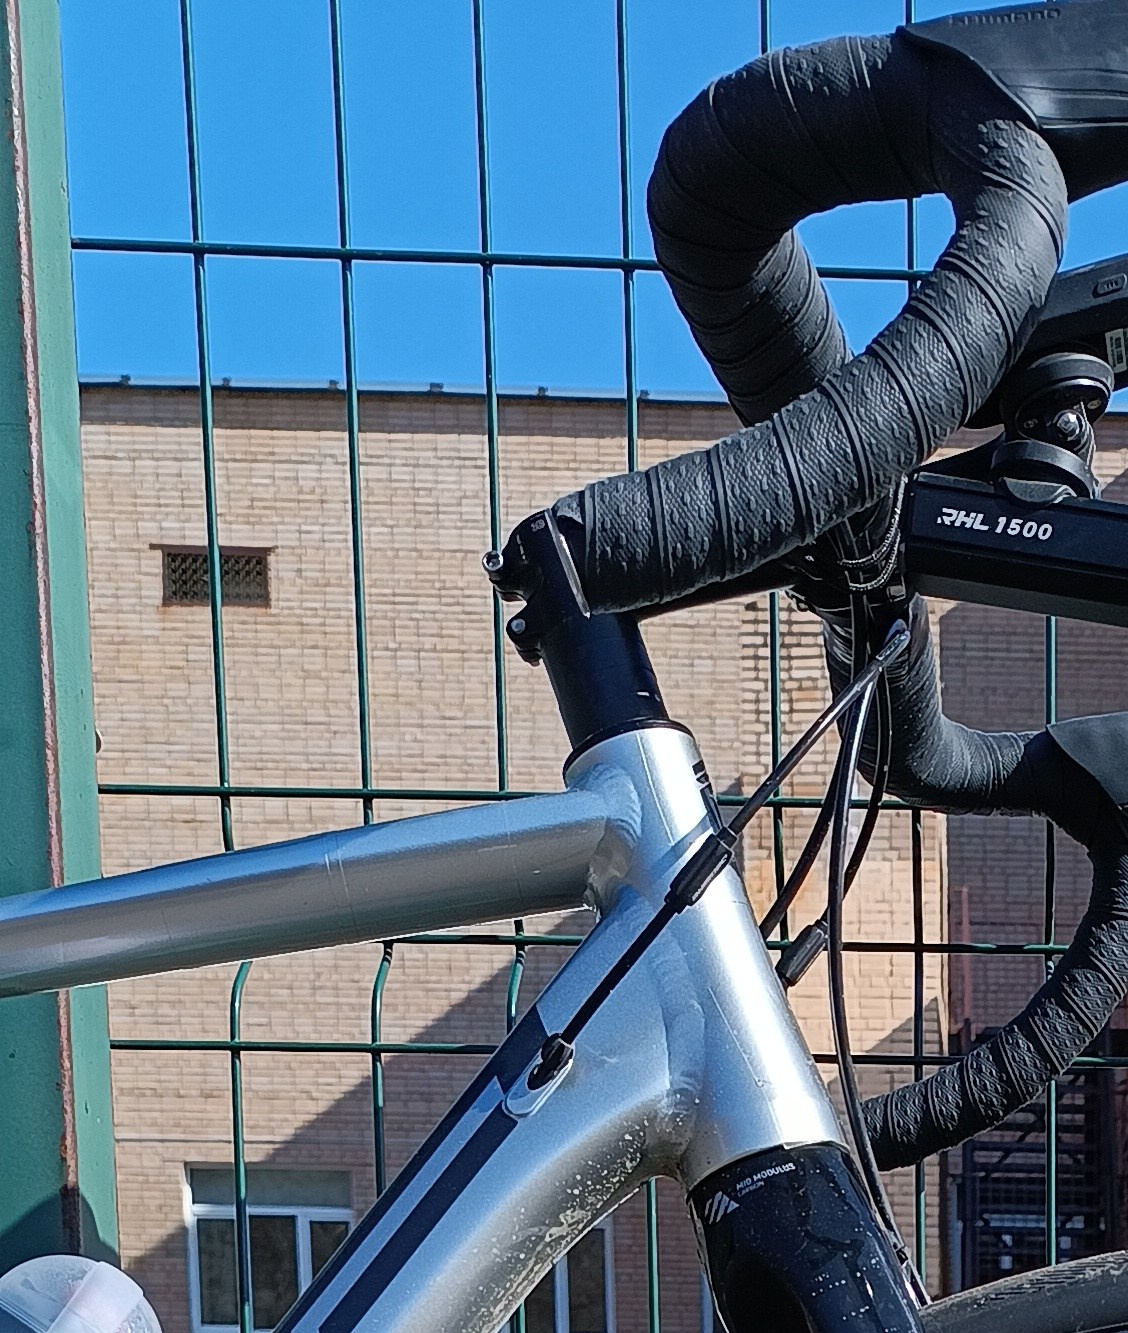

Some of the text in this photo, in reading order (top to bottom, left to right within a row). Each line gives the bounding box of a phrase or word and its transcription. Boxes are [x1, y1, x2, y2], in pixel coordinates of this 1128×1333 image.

[936, 507, 1053, 540] RHL 1500
[752, 1162, 796, 1182] MODULUS
